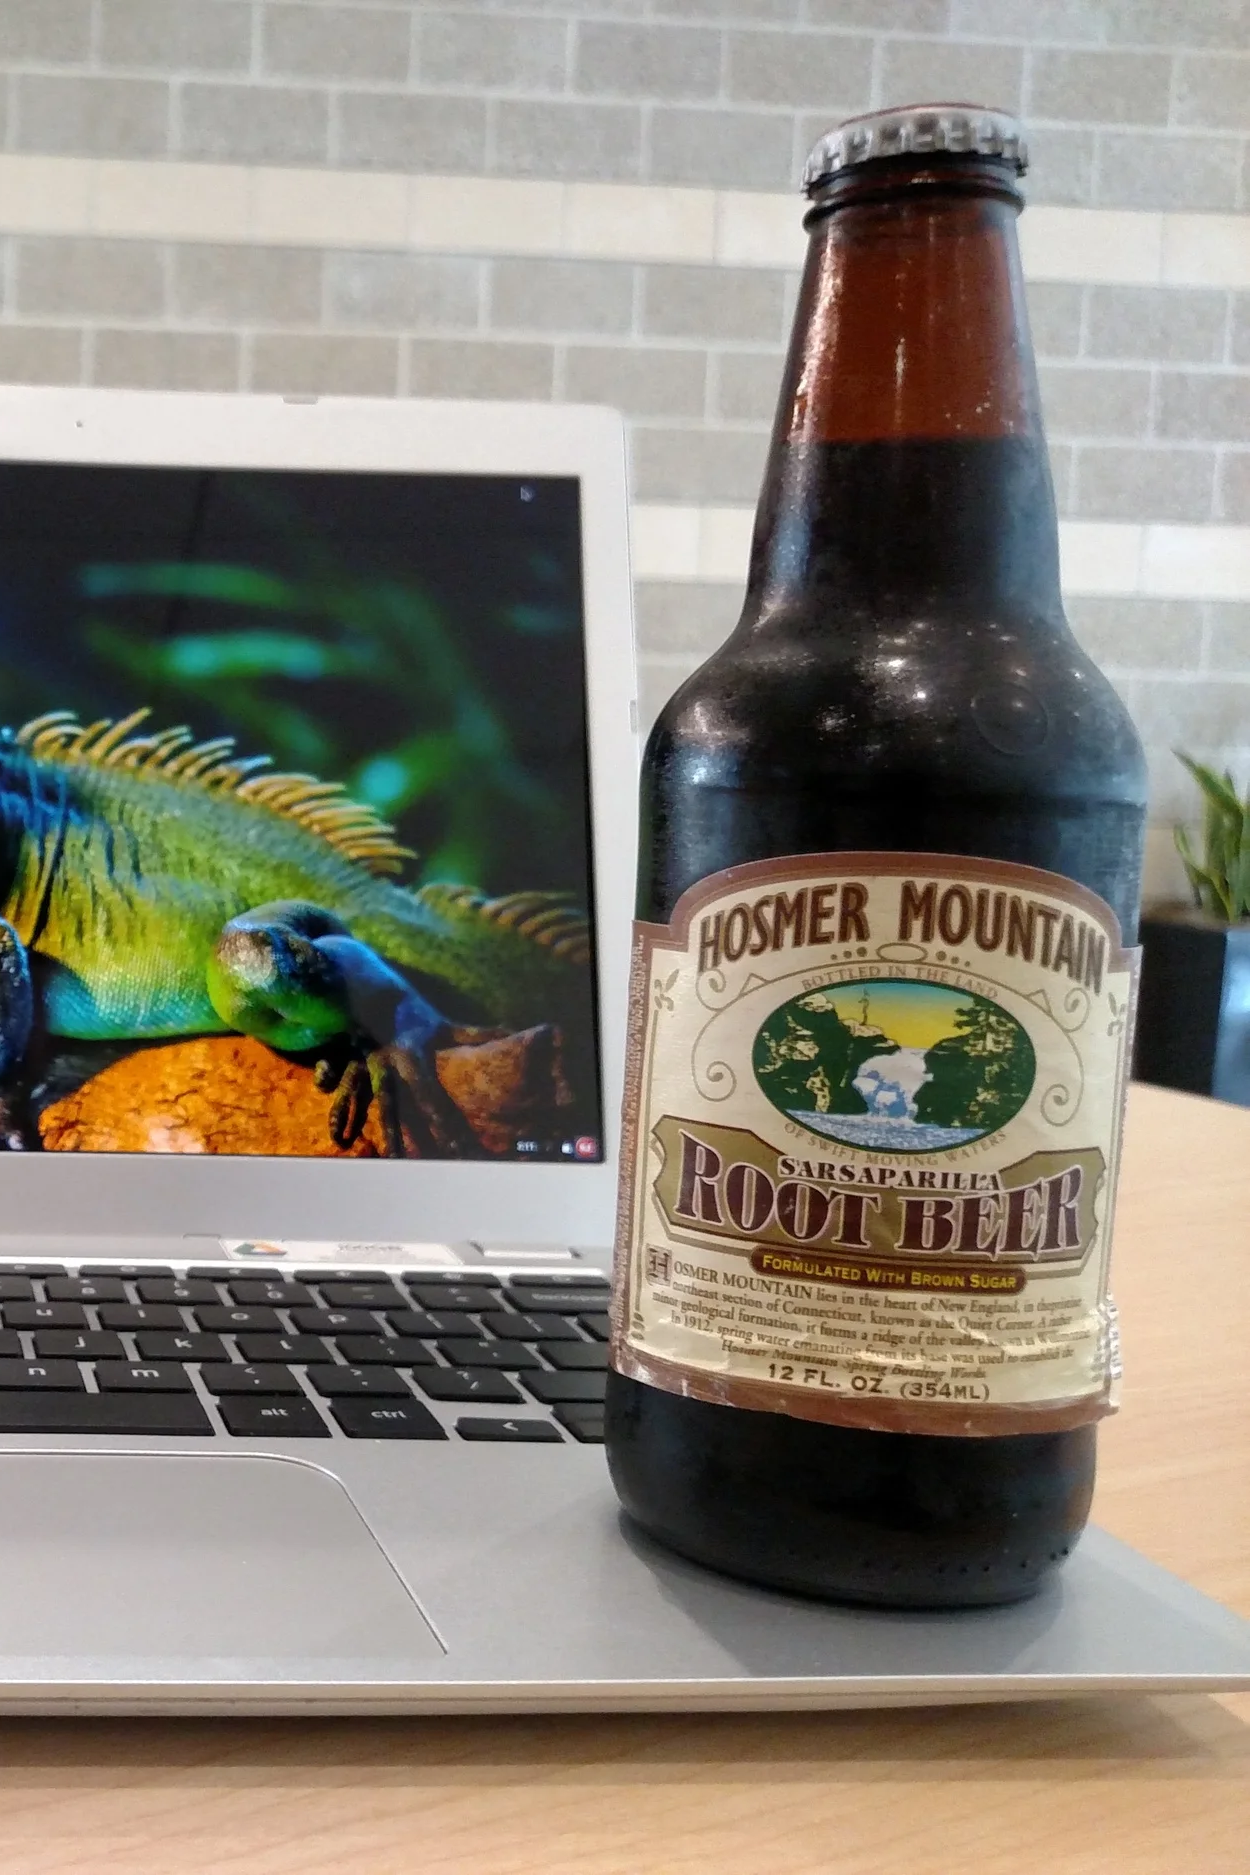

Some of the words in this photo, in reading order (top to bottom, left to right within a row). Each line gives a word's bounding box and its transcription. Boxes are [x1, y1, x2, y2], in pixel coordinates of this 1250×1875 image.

[697, 880, 871, 975] HOSMER
[898, 879, 1105, 995] MOUNTAIN
[801, 965, 881, 991] BOTTLED
[887, 965, 907, 977] IN
[915, 966, 949, 982] THE
[954, 974, 999, 999] LAND
[784, 1122, 803, 1138] OF
[807, 1135, 857, 1161] SWIFT
[865, 1153, 939, 1166] MOVING
[945, 1131, 1007, 1163] WATERS
[779, 1157, 1001, 1191] SARSAPARILLA
[675, 1130, 882, 1248] ROOT
[896, 1166, 1084, 1261] BEER
[762, 1254, 861, 1282] FORMULATED
[911, 1272, 965, 1287] BROWN
[969, 1273, 1017, 1289] SUGAR
[672, 1280, 719, 1301] northeast
[721, 1291, 763, 1310] section
[766, 1299, 781, 1314] of
[782, 1301, 866, 1324] Connecticut,
[870, 1310, 915, 1328] known
[722, 1271, 812, 1299] MOUNTAIN
[816, 1287, 838, 1304] lies
[841, 1291, 855, 1305] in
[859, 1292, 880, 1308] the
[883, 1295, 918, 1311] heart
[920, 1298, 937, 1311] of
[938, 1299, 967, 1312] New
[36, 1308, 53, 1317] u
[231, 1312, 250, 1321] o
[680, 1300, 735, 1322] geological
[737, 1308, 803, 1334] formation,
[806, 1320, 817, 1335] it
[820, 1321, 857, 1341] forms
[861, 1331, 868, 1341] a
[872, 1327, 906, 1348] ridge
[908, 1331, 924, 1345] of
[926, 1330, 946, 1346] the
[174, 1337, 193, 1349] k
[670, 1308, 681, 1325] In
[717, 1323, 754, 1345] spring
[757, 1331, 791, 1347] water
[951, 1353, 975, 1364] was
[978, 1350, 1005, 1366] used
[28, 1367, 47, 1376] n
[131, 1368, 160, 1378] m
[768, 1362, 794, 1381] 12
[803, 1367, 841, 1388] FL.
[851, 1374, 890, 1394] OZ.
[900, 1381, 990, 1403] (354ML)
[260, 1407, 289, 1417] alt
[370, 1409, 408, 1419] ctrl
